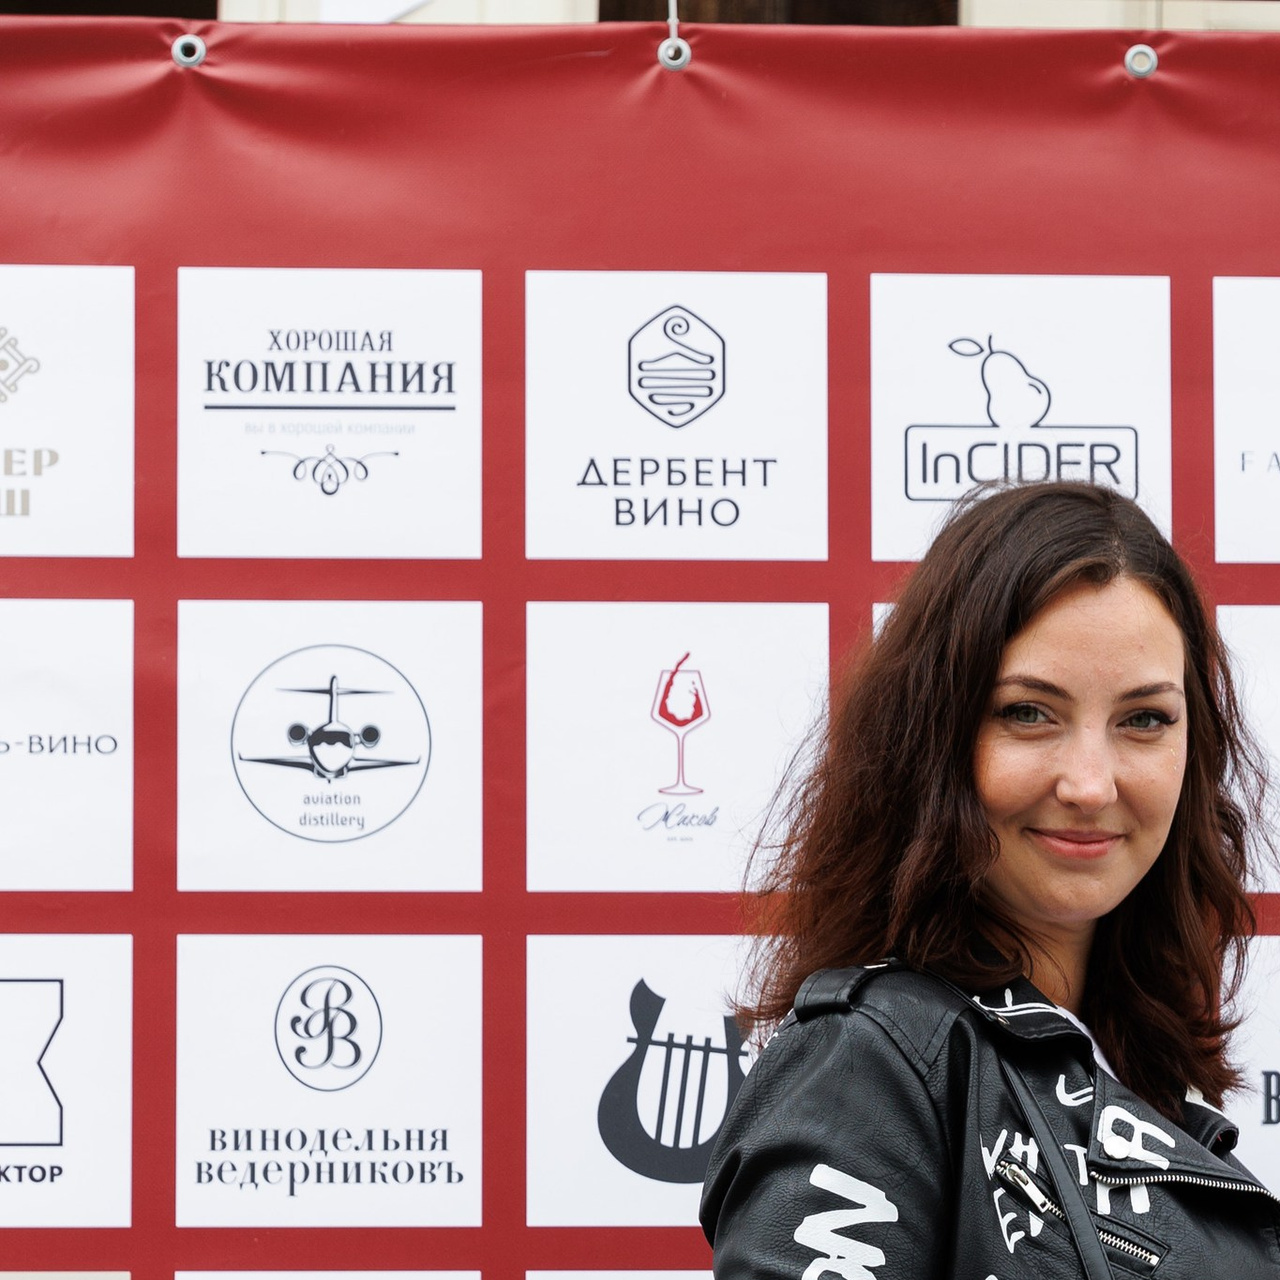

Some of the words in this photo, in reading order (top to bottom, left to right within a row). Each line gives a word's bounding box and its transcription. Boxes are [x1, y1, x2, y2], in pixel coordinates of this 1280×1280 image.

[268, 330, 394, 352] ХОРОШАЯ
[204, 360, 456, 394] КОМПАНИЯ
[576, 459, 777, 487] ДЕРБЕНТ
[921, 443, 1123, 484] InCIDER
[614, 498, 741, 527] ВИНО
[303, 791, 361, 805] aviation
[298, 811, 366, 831] distillery
[209, 1126, 449, 1156] винодельня
[195, 1158, 464, 1197] ведерниковъ
